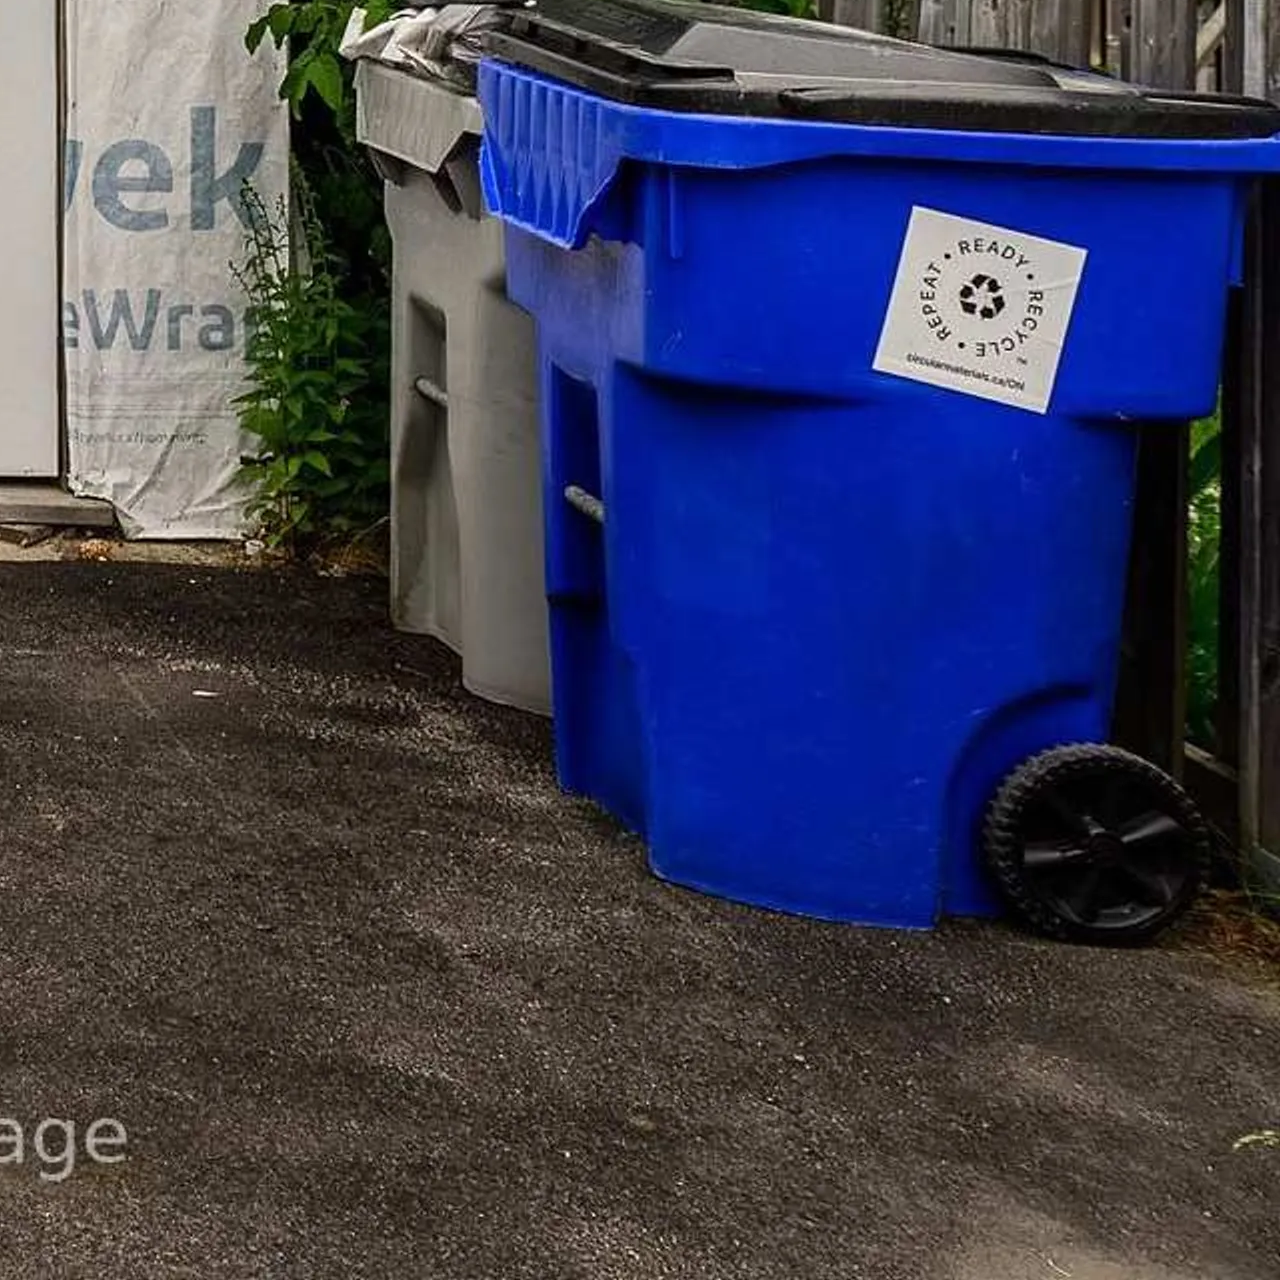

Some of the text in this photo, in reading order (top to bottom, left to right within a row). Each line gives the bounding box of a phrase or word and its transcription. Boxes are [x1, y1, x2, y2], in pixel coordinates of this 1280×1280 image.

[66, 105, 269, 232] ek
[920, 237, 1044, 358] READY RECYCLE REPEAT
